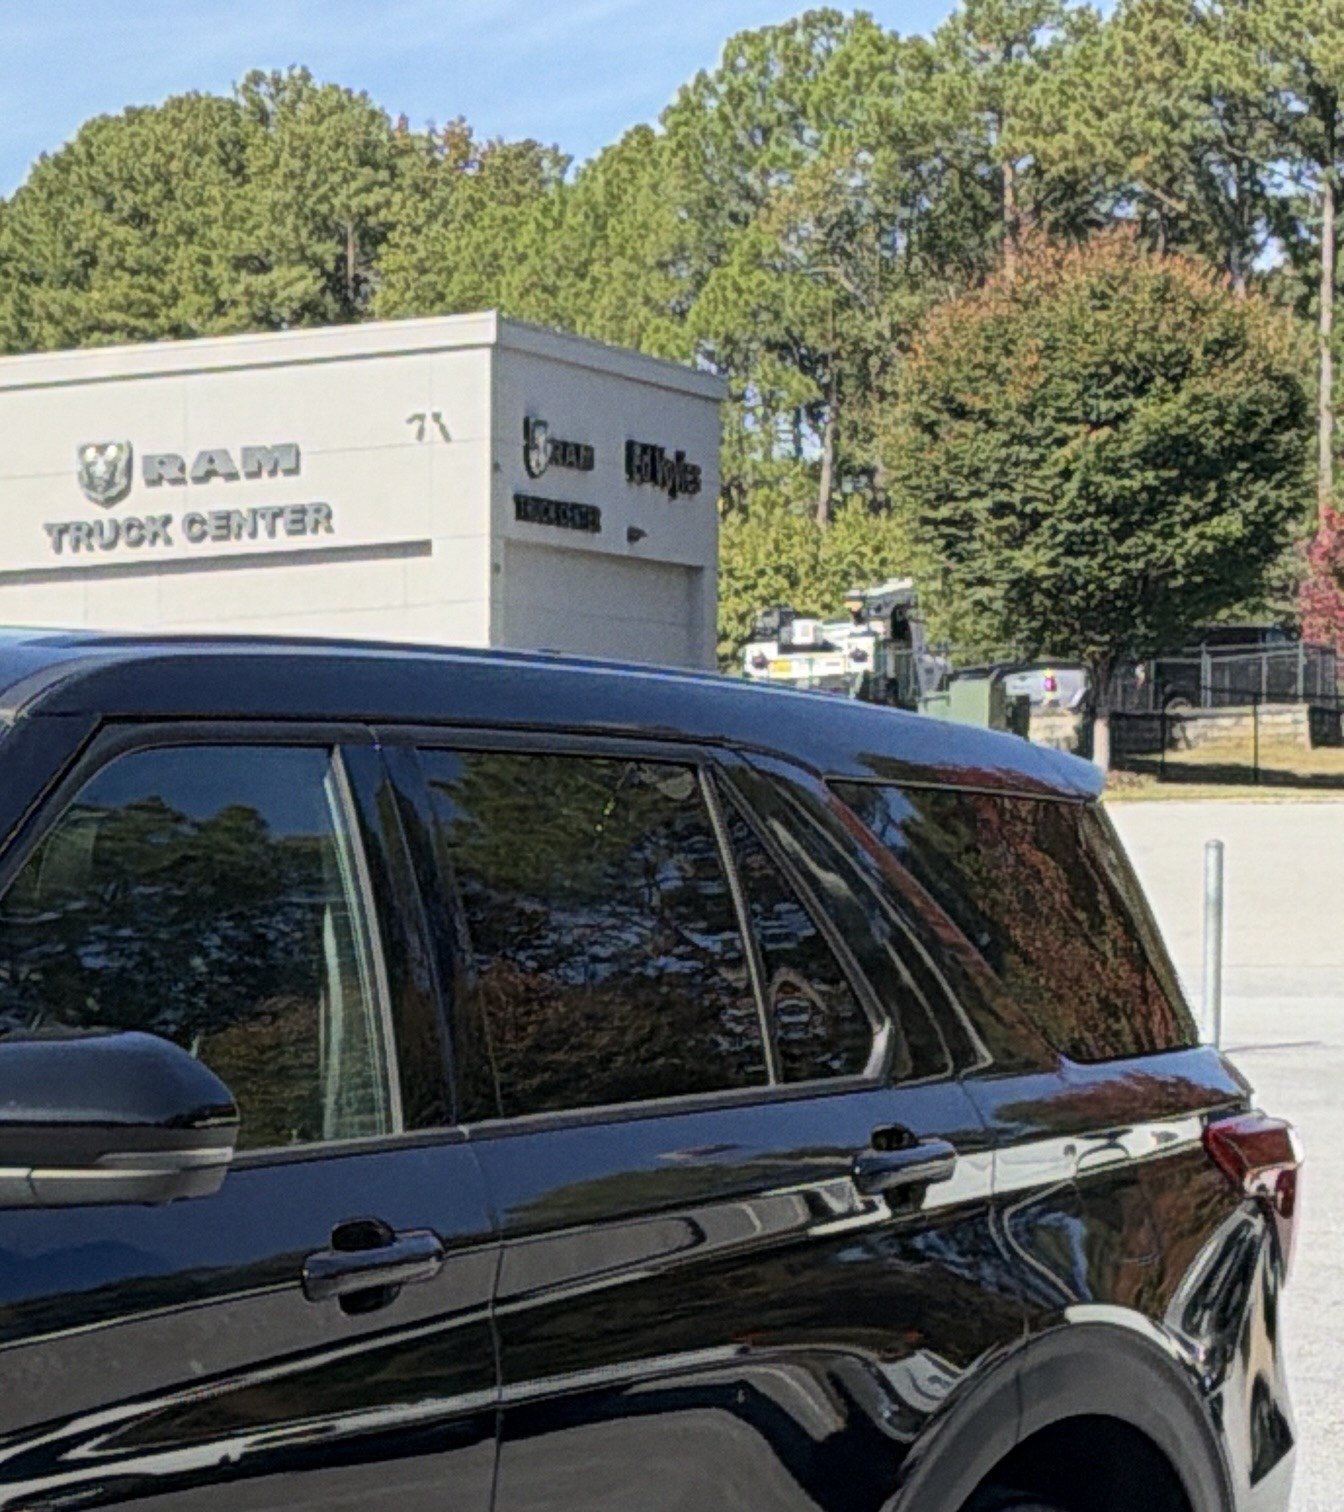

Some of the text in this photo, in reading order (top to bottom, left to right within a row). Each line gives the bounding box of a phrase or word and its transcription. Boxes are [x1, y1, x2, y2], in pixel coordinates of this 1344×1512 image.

[141, 442, 302, 489] RAM
[43, 501, 334, 555] TRUCK CENTER
